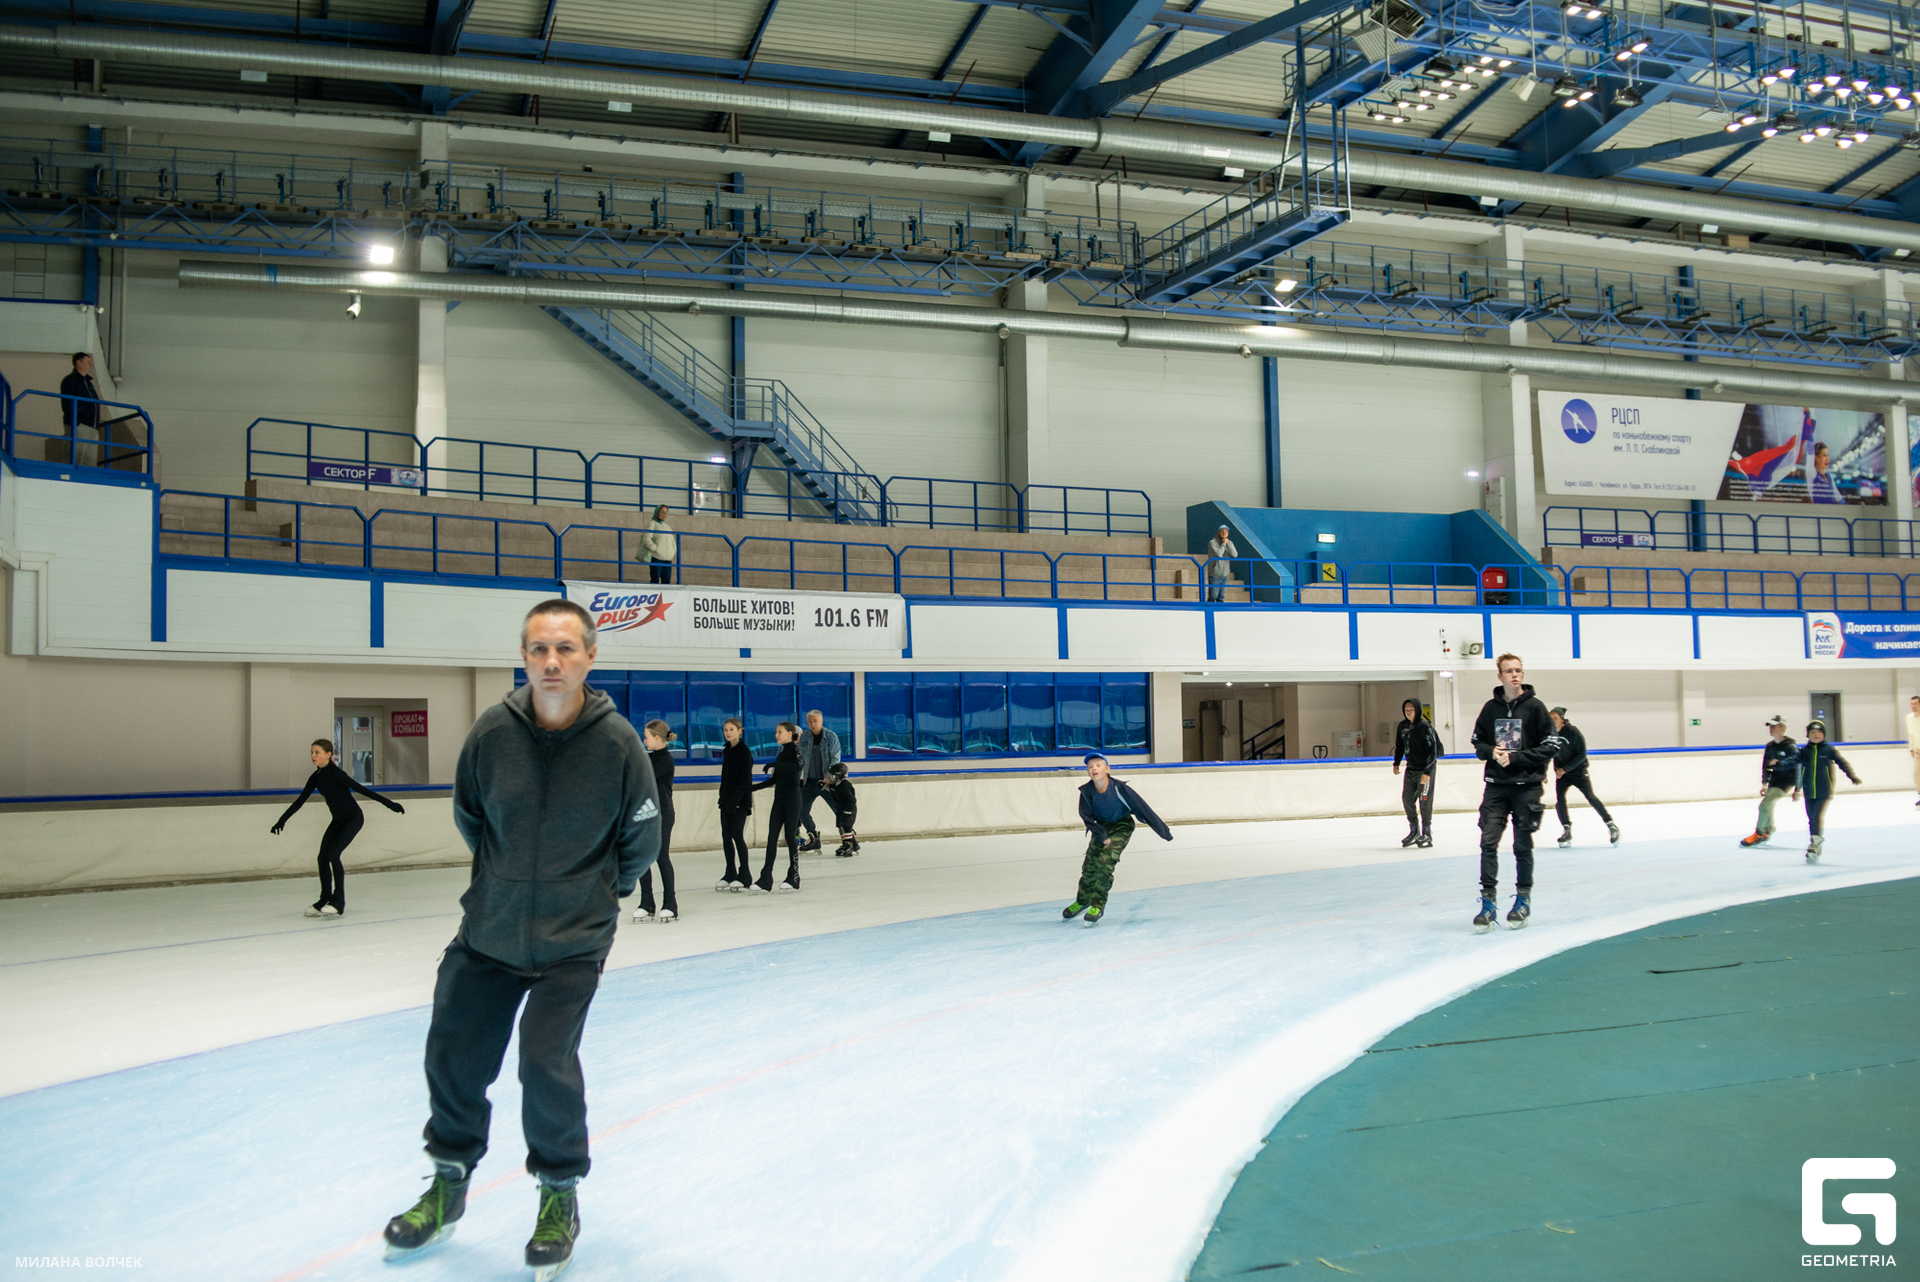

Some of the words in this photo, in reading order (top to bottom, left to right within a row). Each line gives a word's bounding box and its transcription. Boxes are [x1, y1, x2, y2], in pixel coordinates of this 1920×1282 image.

[1611, 407, 1641, 427] РЦСП
[1613, 431, 1621, 439] по
[324, 466, 366, 479] СЕКТОР
[368, 468, 377, 480] F
[1592, 535, 1617, 544] СЕКТОР
[693, 597, 748, 614] БОЛЬШЕ
[751, 600, 795, 616] ХИТОВ!
[693, 616, 740, 630] БОЛЬШЕ
[743, 618, 795, 632] МУЗЫКИ!
[814, 607, 861, 628] 101.6
[866, 608, 889, 628] FM
[1845, 621, 1883, 635] Дорога
[1885, 624, 1892, 632] к
[1893, 624, 1920, 633] олим
[394, 714, 418, 724] ПРОКАТ
[394, 724, 425, 734] КОНЬКОВ
